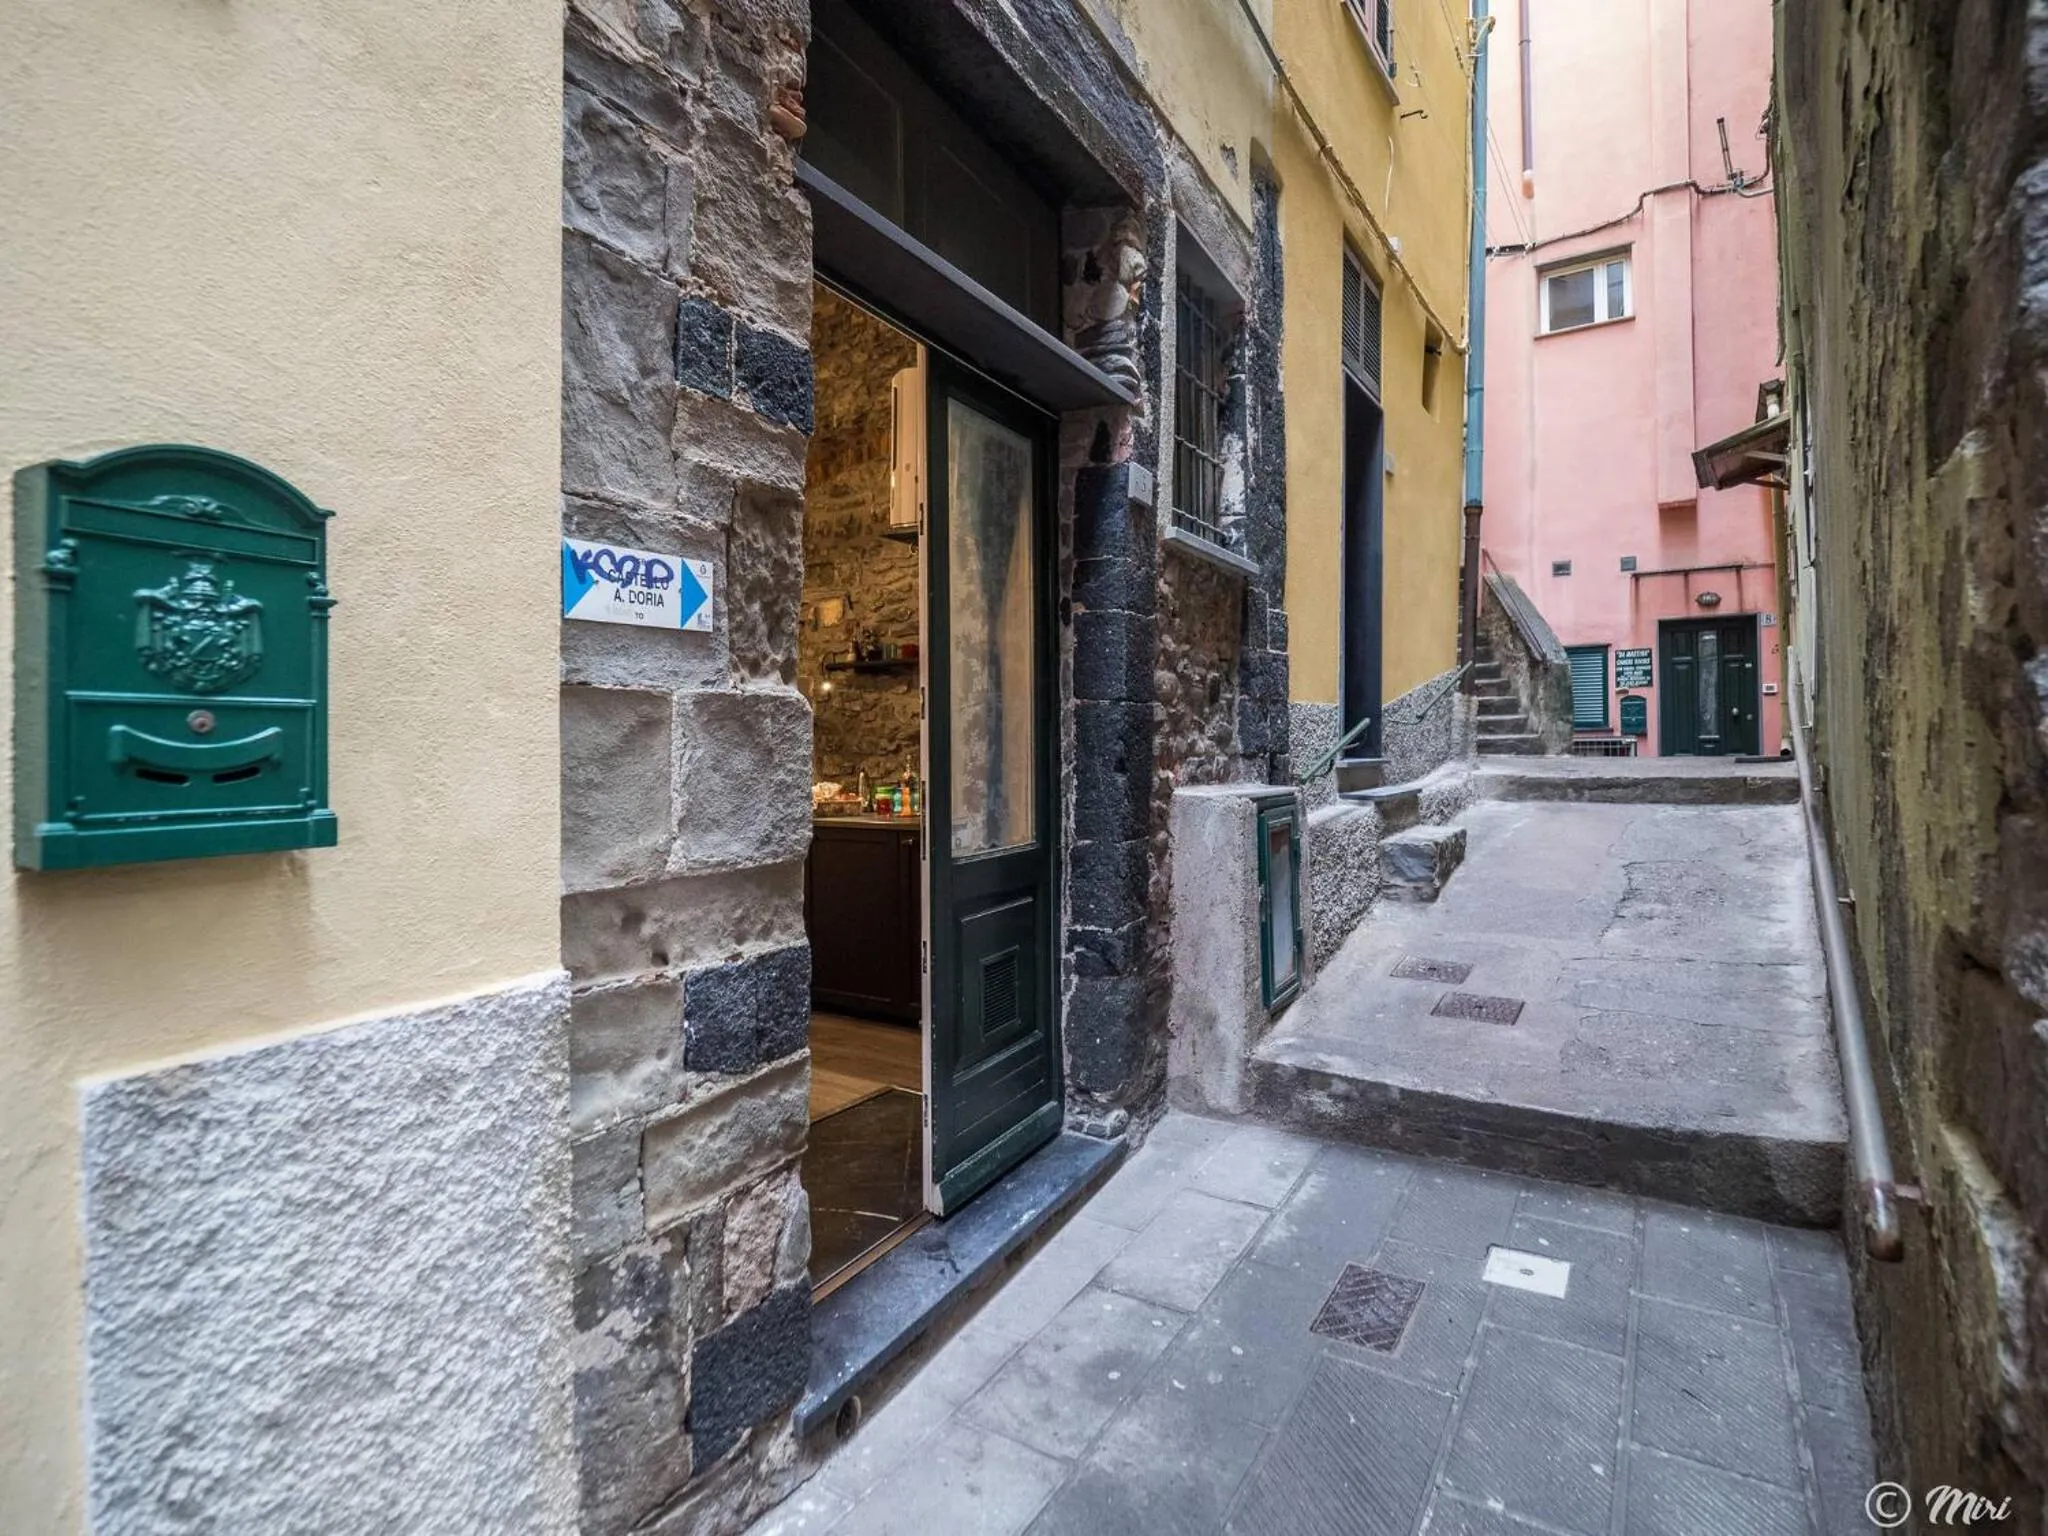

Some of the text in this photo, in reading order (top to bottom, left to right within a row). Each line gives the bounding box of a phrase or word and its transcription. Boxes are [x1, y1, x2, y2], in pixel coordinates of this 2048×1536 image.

[608, 568, 670, 590] CATELO
[614, 588, 665, 608] A. DORIA
